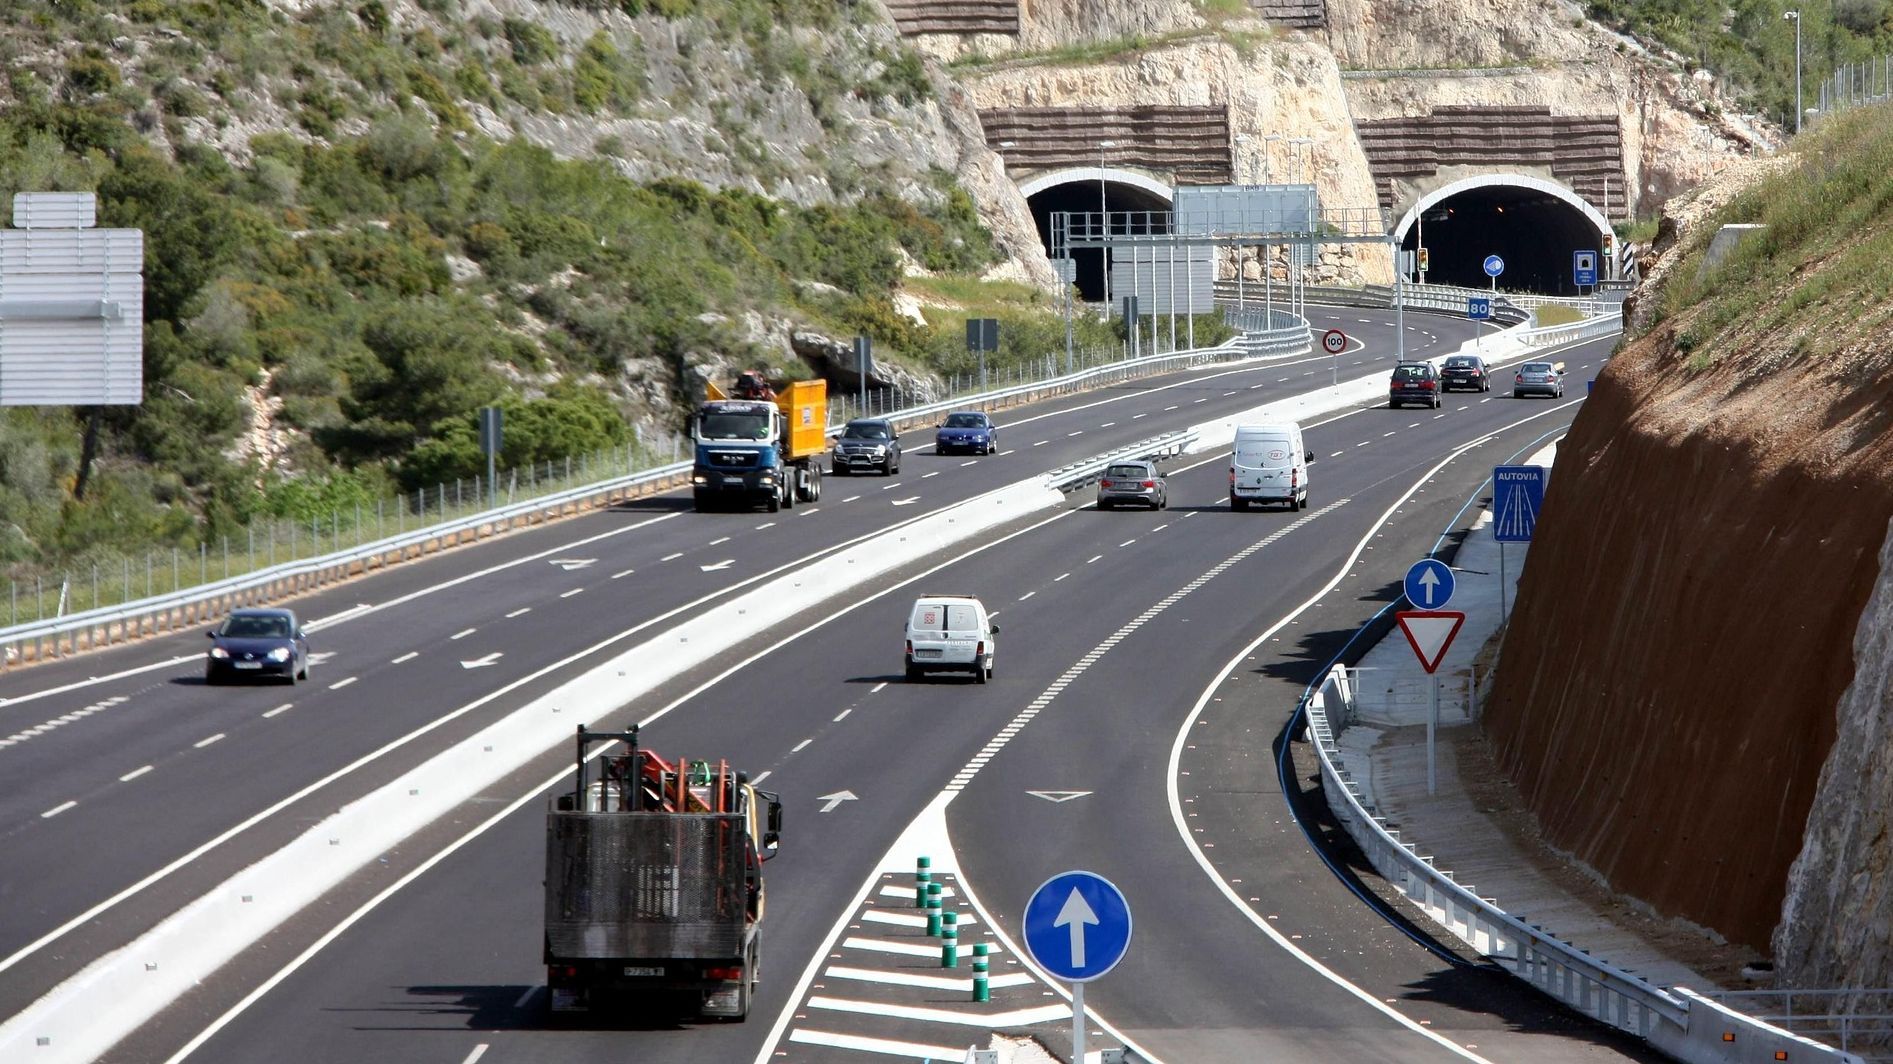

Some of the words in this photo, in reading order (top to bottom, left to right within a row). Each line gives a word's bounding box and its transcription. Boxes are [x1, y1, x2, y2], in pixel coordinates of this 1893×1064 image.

[1470, 303, 1487, 314] 80
[1327, 337, 1342, 346] 100
[1497, 472, 1539, 481] AUTOVIA
